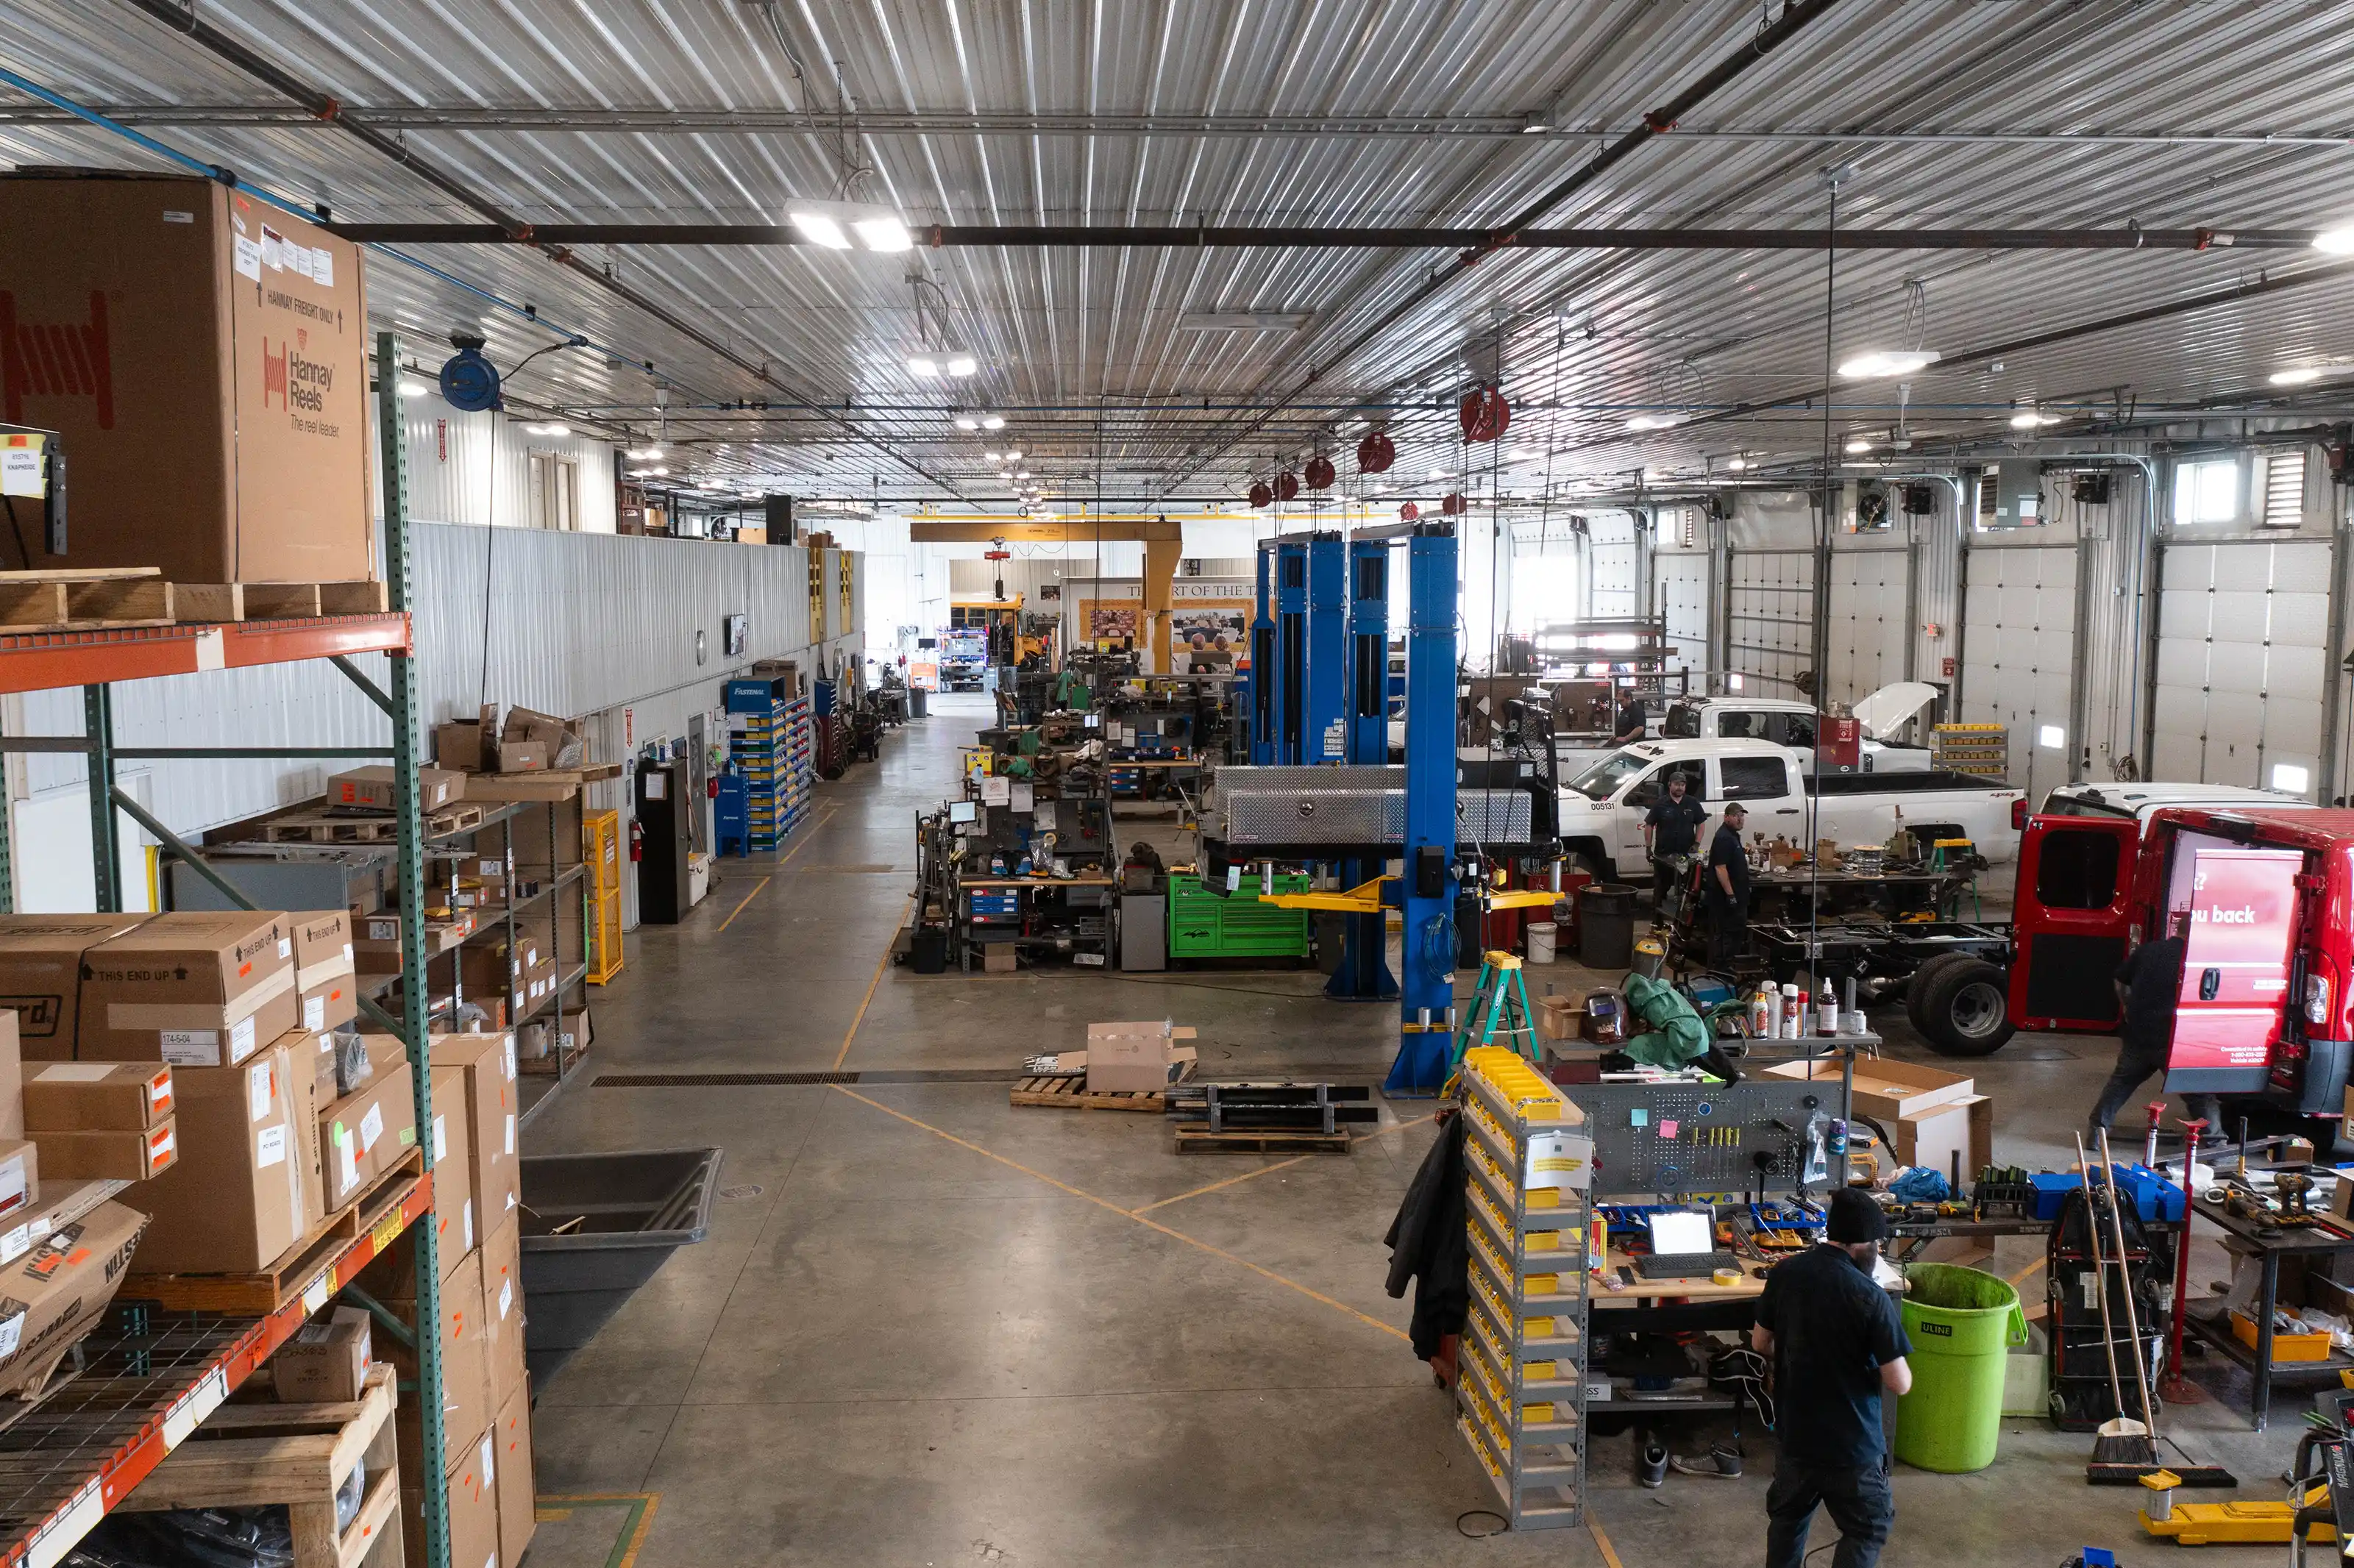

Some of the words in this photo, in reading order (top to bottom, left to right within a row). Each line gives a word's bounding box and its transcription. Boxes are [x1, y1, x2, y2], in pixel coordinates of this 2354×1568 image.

[268, 288, 292, 312] HANNAY
[294, 298, 318, 319] FREIGHT
[319, 307, 333, 324] ONLY
[290, 351, 333, 393] Hannay
[291, 379, 322, 412] Reels
[291, 413, 303, 432] The
[305, 417, 318, 435] reel
[1173, 586, 1188, 596] RT
[1191, 585, 1209, 596] OF
[1214, 586, 1242, 596] THE
[2211, 905, 2256, 924] back
[313, 930, 321, 941] THIS
[321, 927, 330, 938] END
[330, 925, 336, 935] UP
[243, 944, 255, 958] THIS
[255, 938, 265, 950] END
[266, 934, 272, 945] UP
[99, 972, 124, 982] THIS
[128, 971, 151, 981] END
[154, 971, 169, 981] UP
[163, 1034, 191, 1043] 174-5-04
[313, 1146, 318, 1159] UP
[1923, 1324, 1950, 1335] ULINE
[2333, 1450, 2350, 1489] MAGNUM
